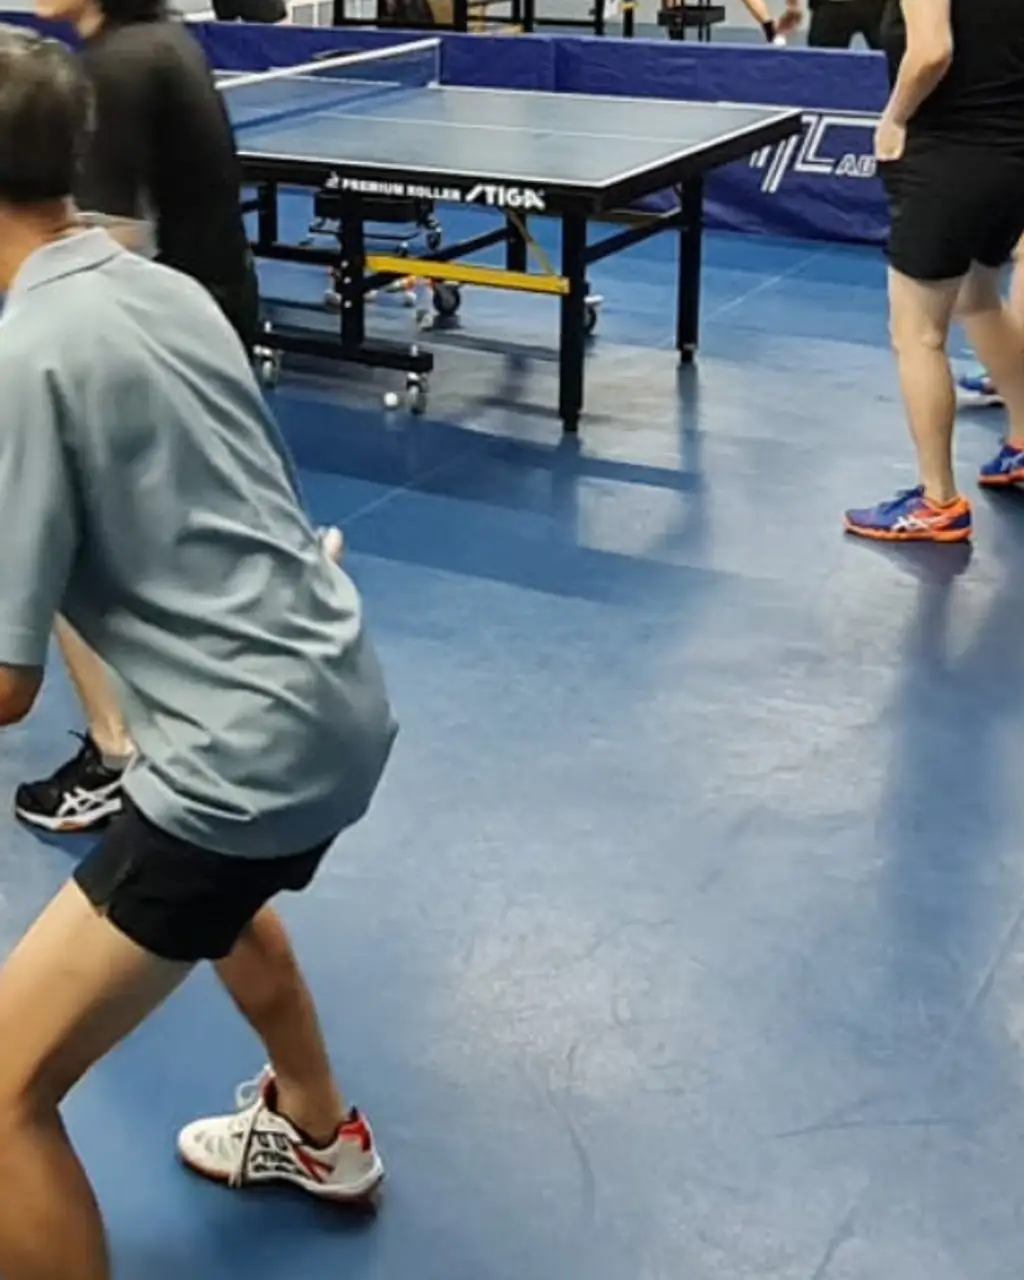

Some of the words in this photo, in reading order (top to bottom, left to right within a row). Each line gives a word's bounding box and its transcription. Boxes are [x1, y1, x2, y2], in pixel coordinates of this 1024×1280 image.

[341, 177, 404, 196] PREMIUM
[406, 183, 461, 201] ROLLER
[465, 183, 546, 210] STIGA
